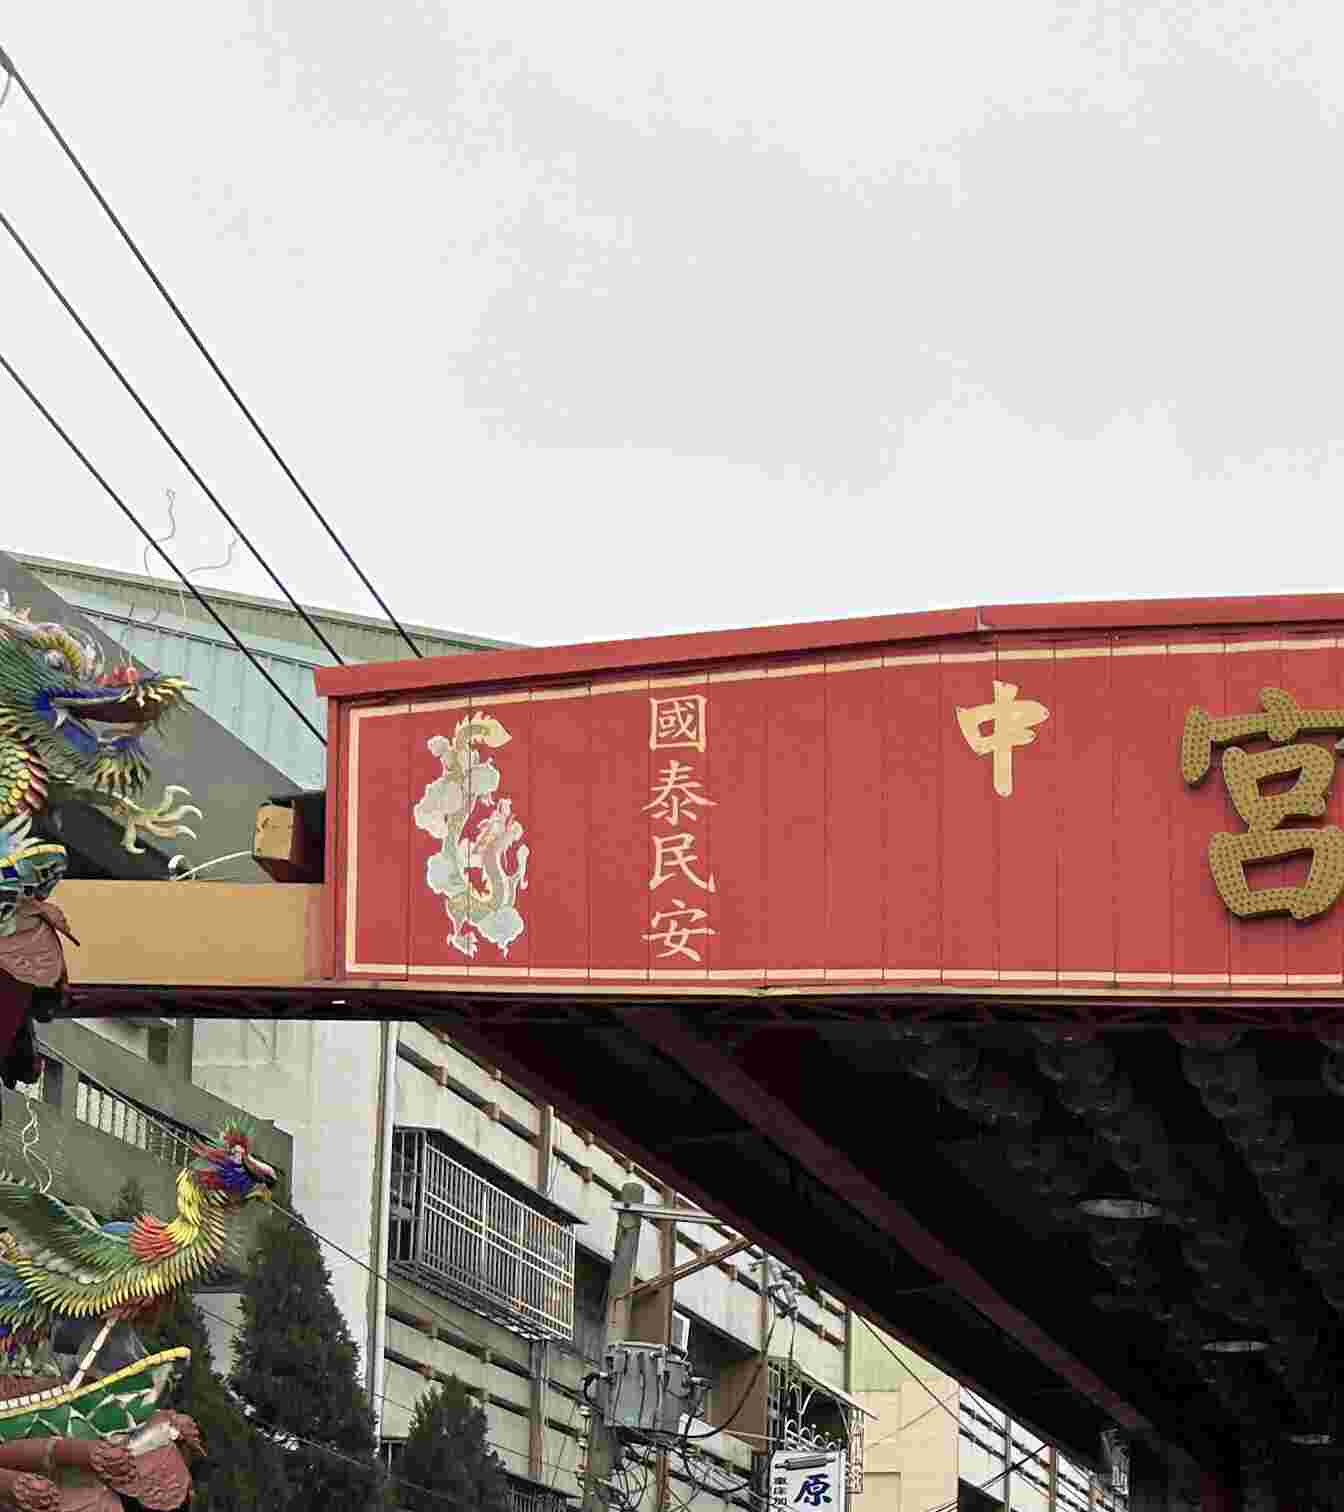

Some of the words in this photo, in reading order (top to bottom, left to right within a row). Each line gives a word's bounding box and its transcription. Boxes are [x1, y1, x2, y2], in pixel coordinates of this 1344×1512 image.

[641, 694, 718, 963] 國泰民安
[955, 680, 1050, 798] 中
